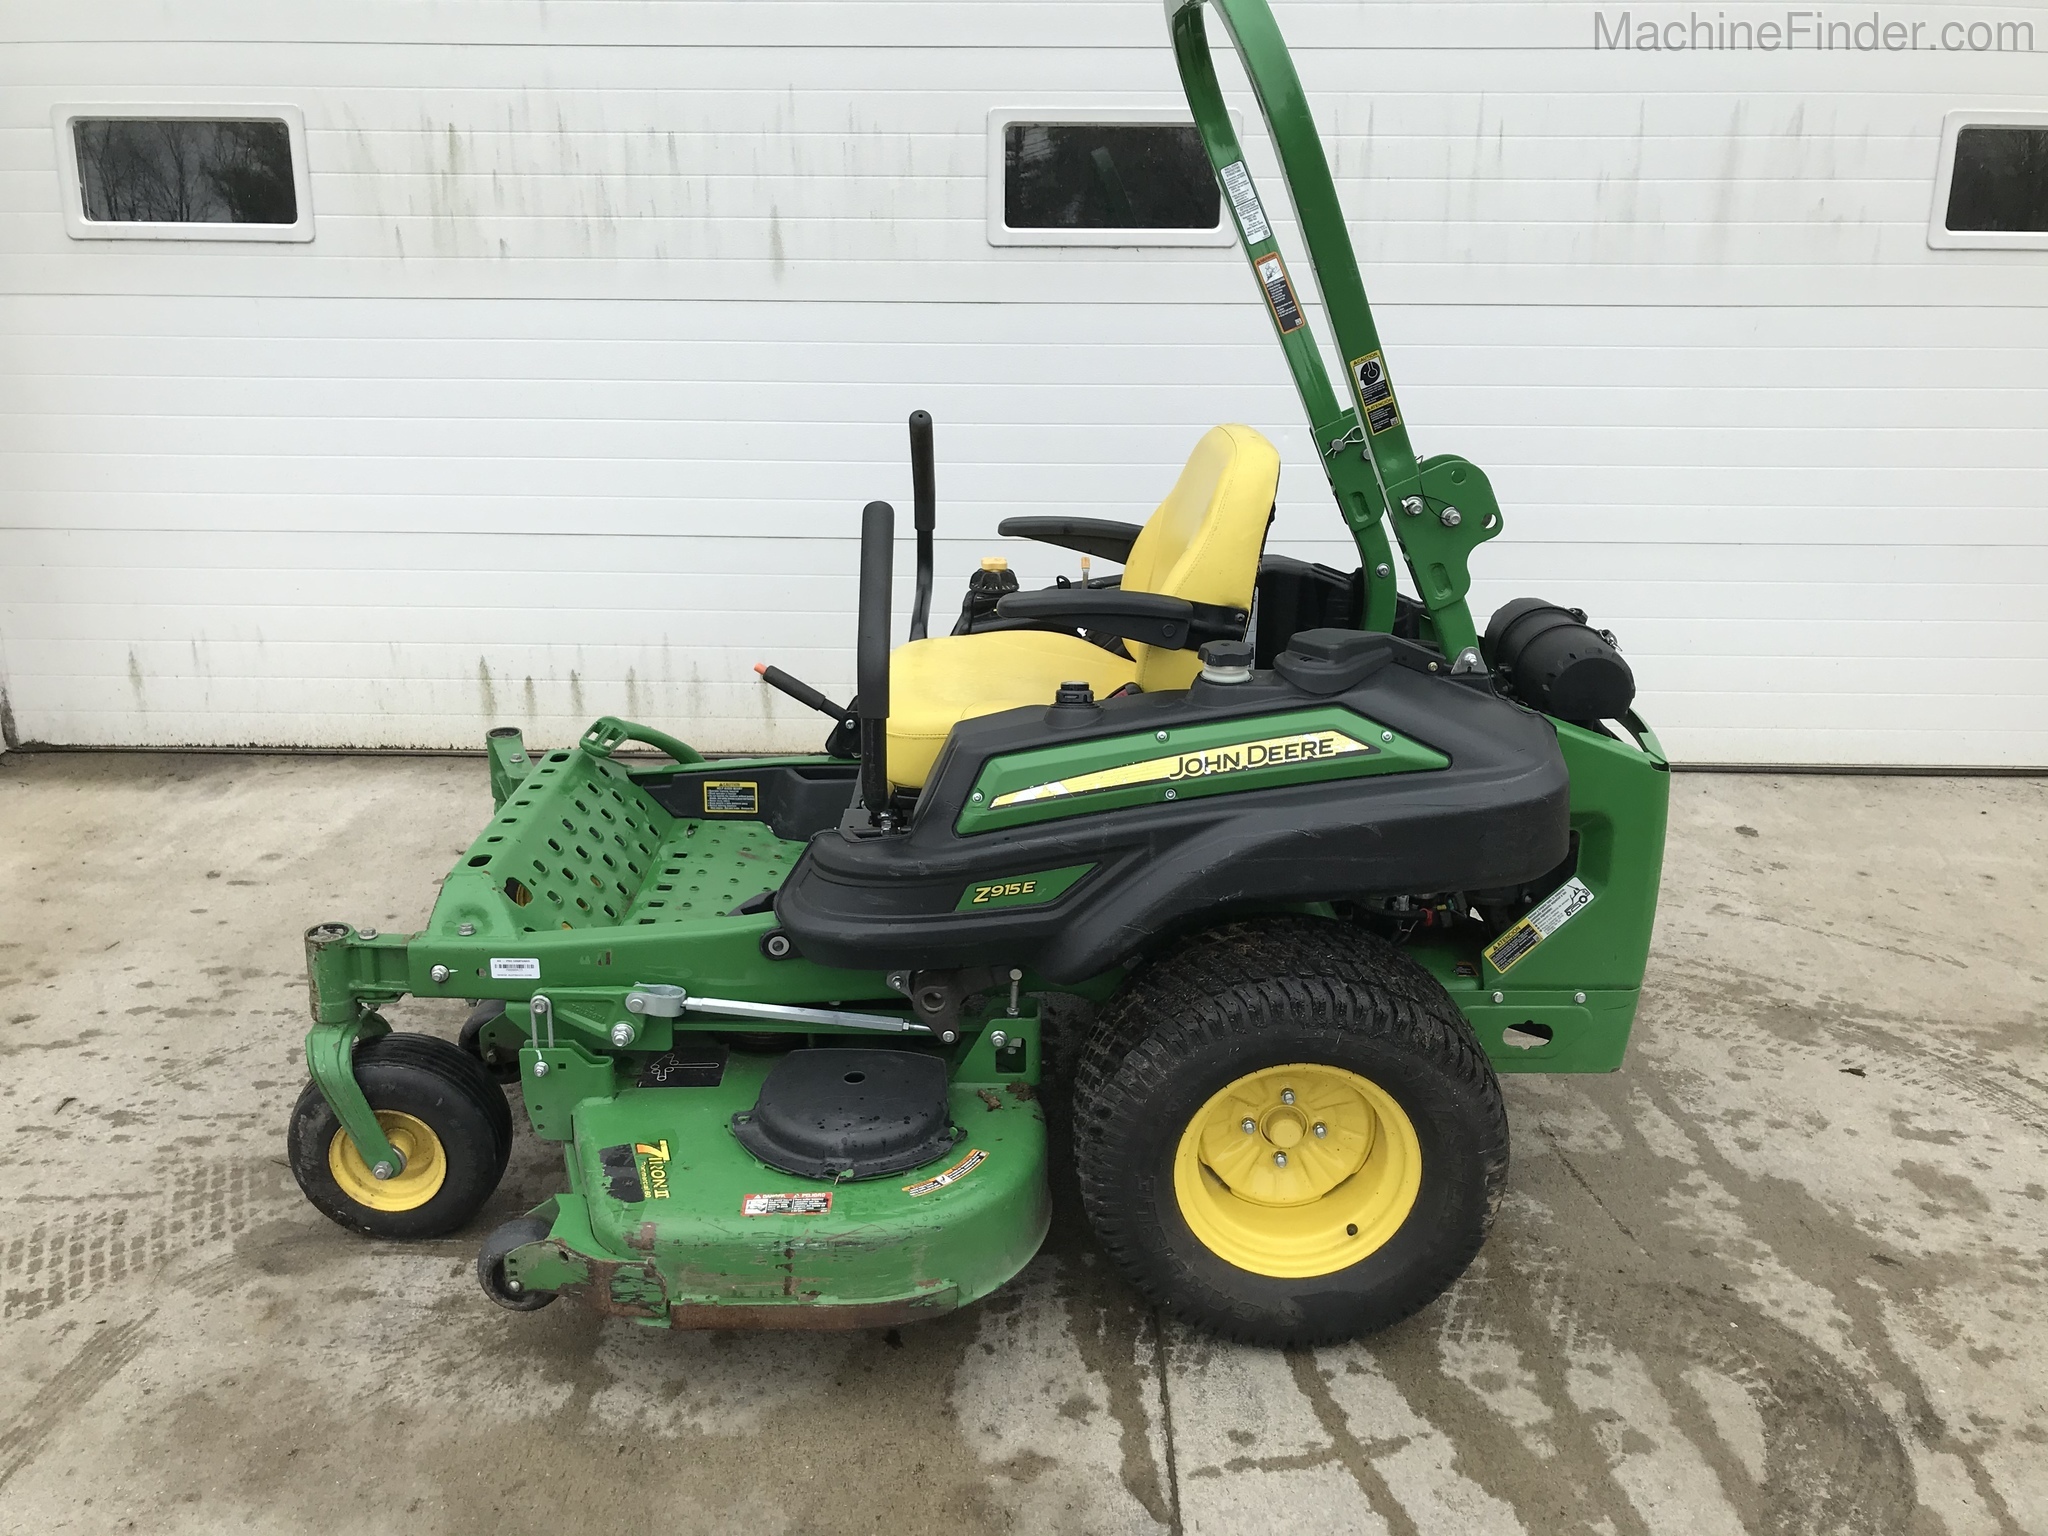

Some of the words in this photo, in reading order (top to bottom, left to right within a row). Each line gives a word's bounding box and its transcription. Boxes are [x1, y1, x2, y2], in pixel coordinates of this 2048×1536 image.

[1357, 352, 1378, 363] CAUTION
[1170, 751, 1240, 778] JOHN
[1247, 737, 1334, 765] DEERE
[635, 1139, 671, 1161] 7
[648, 1157, 668, 1188] IRON
